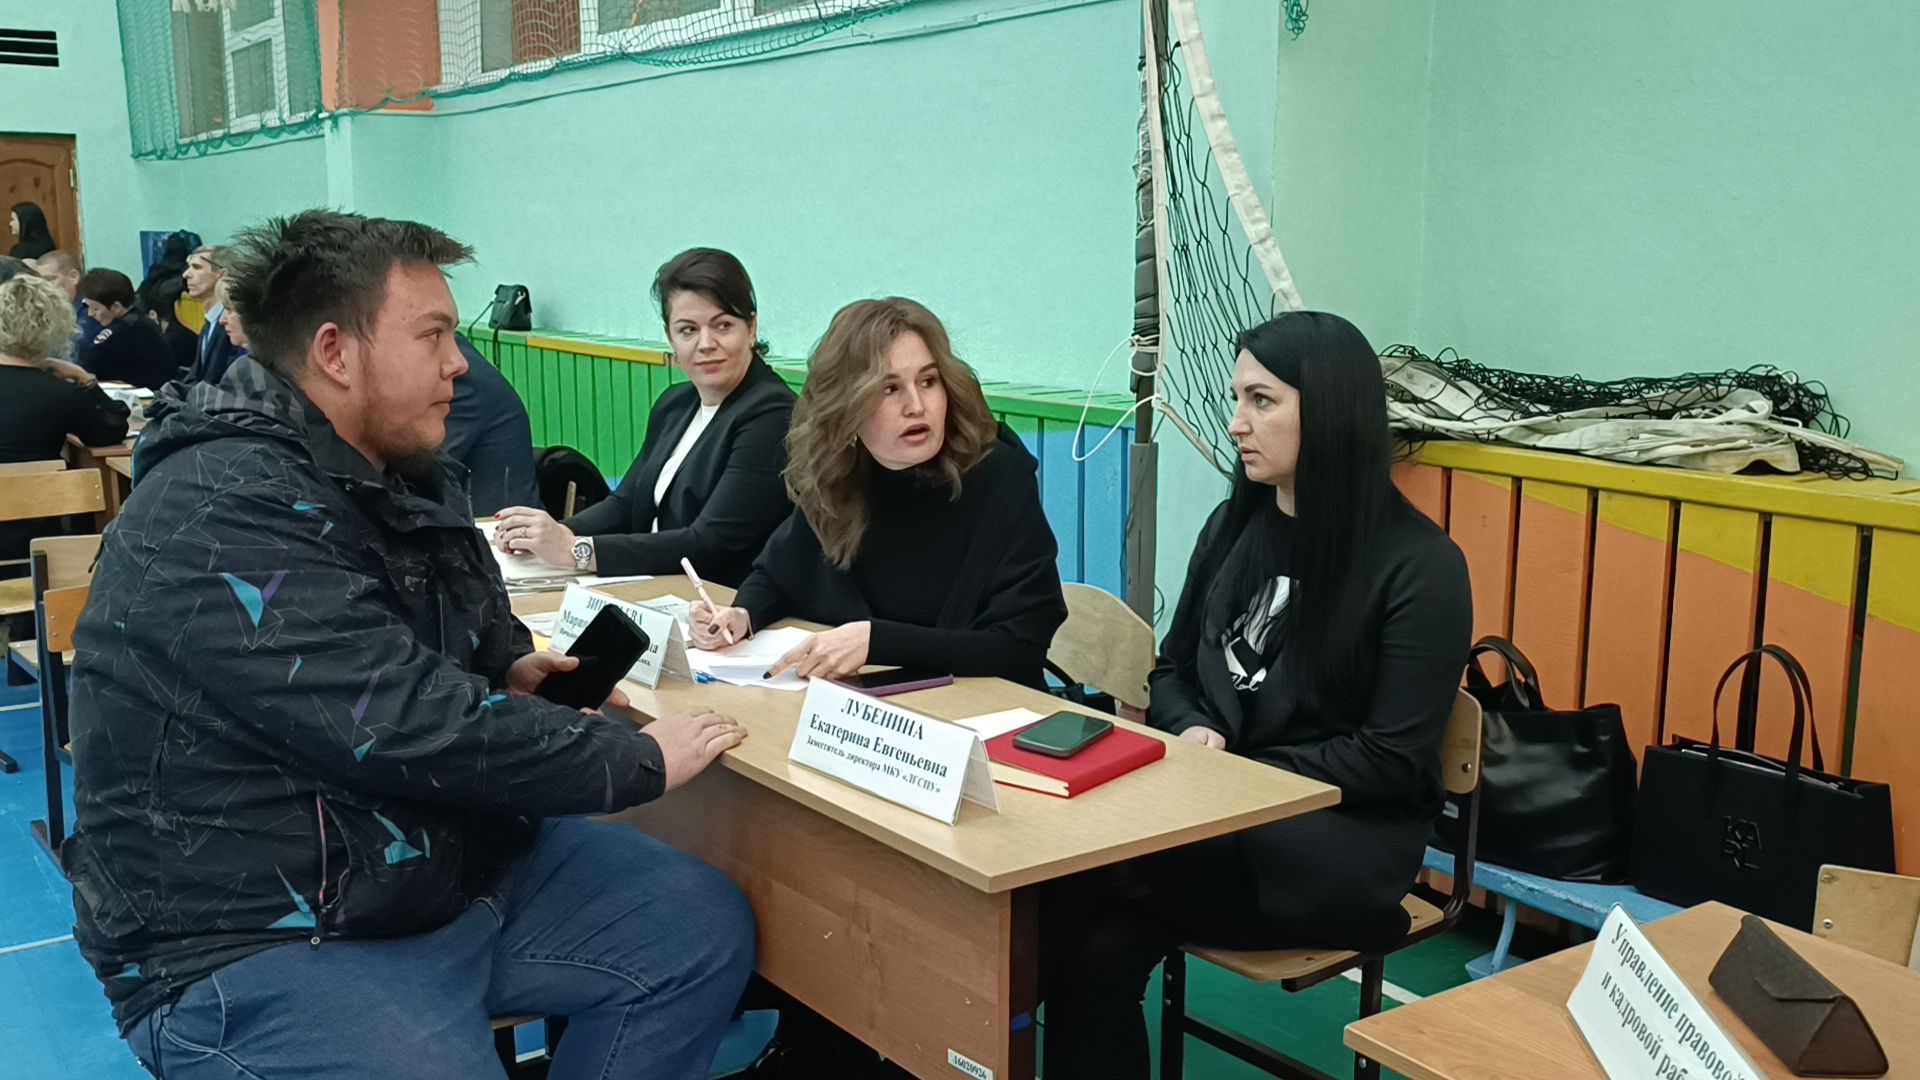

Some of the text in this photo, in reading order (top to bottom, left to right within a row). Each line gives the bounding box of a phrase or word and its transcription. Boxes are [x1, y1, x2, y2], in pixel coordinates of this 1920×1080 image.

[811, 714, 948, 778] Екатерина Евгеньевна
[840, 698, 924, 741] ЛУБЕНИНА
[807, 735, 846, 758] Заместитель
[845, 751, 881, 772] директора
[882, 764, 903, 779] МКУ
[1611, 922, 1679, 1019] Управление
[1601, 972, 1612, 990] и
[1609, 983, 1664, 1060] кадровой
